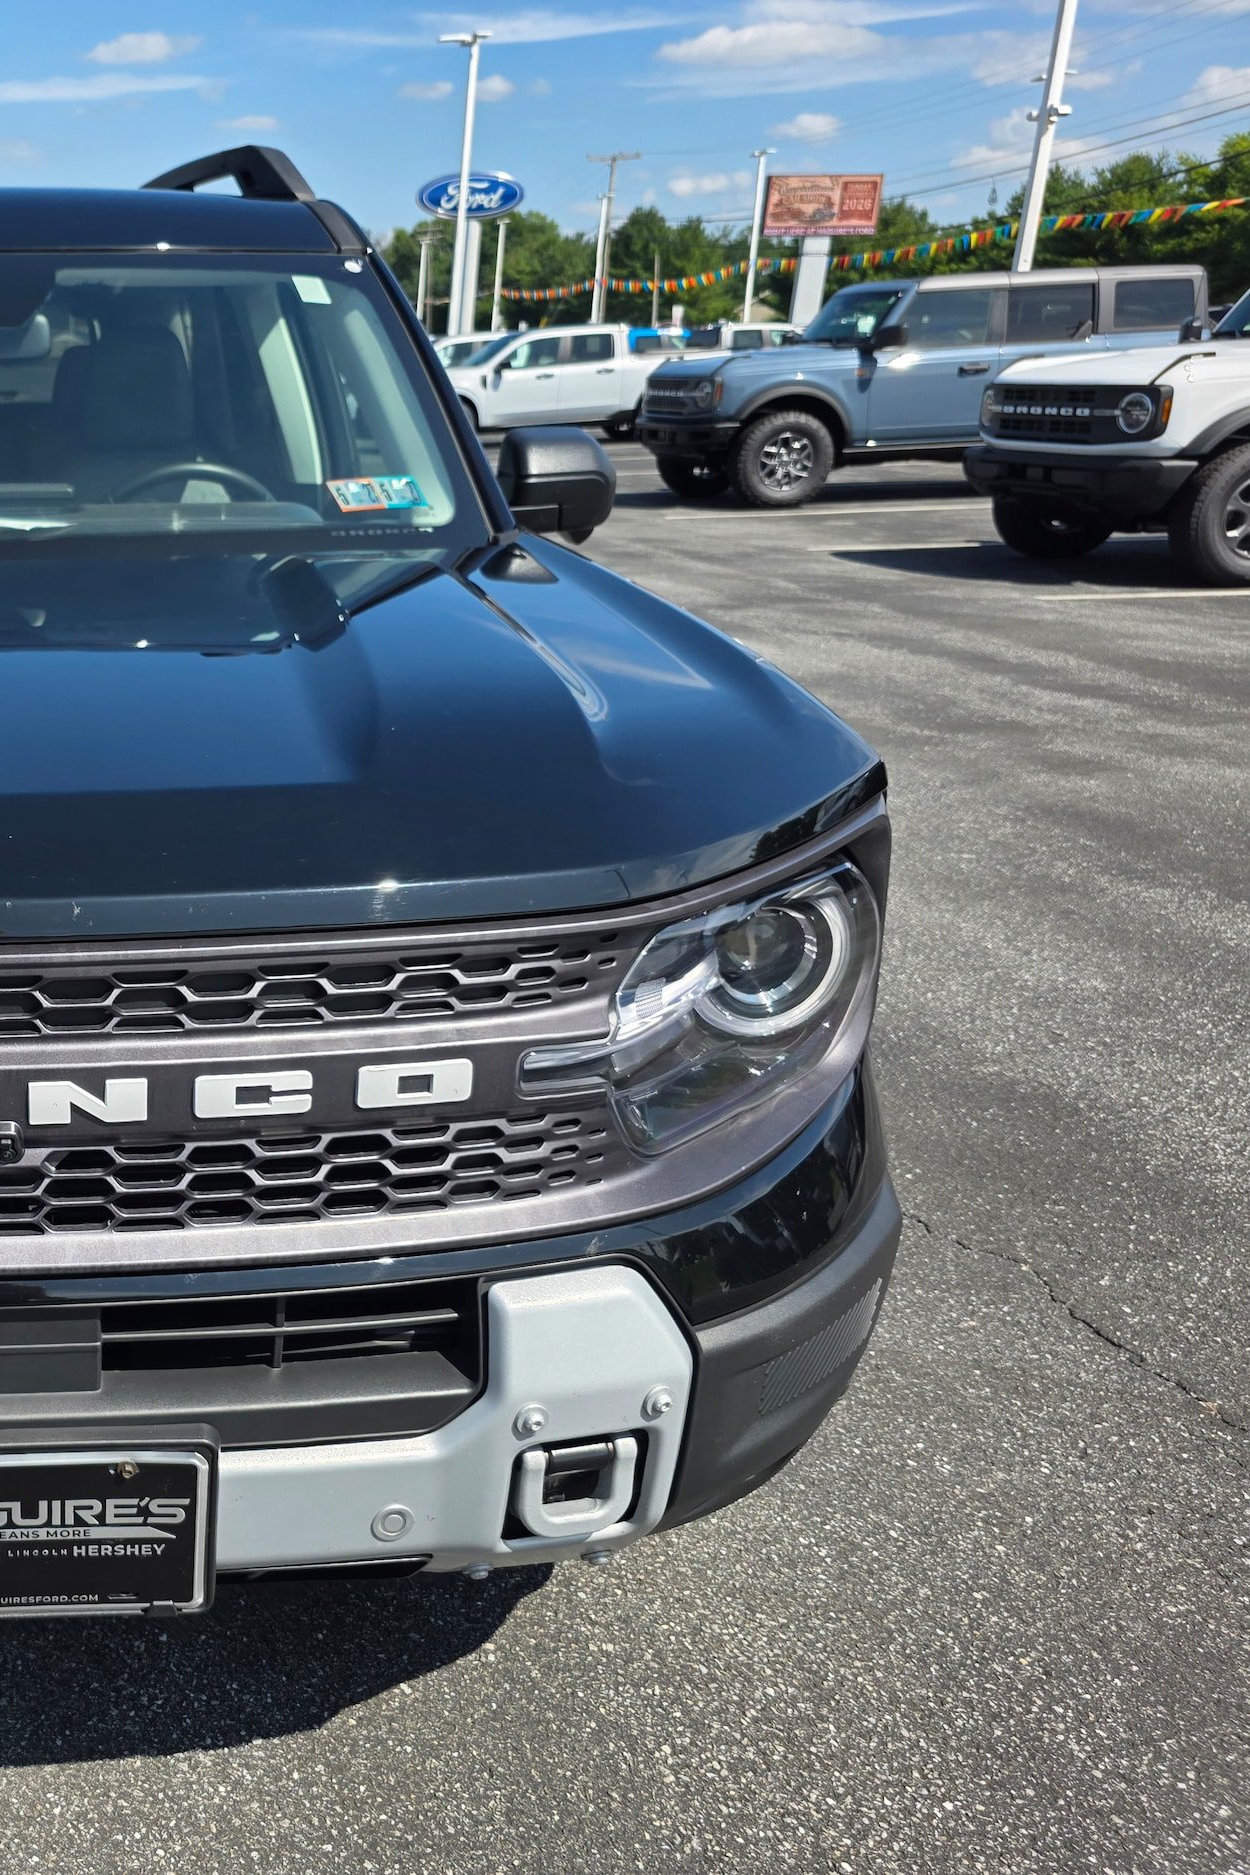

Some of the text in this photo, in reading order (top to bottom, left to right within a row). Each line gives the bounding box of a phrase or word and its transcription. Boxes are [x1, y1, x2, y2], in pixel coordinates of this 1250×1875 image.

[1003, 405, 1090, 417] BRONCO
[46, 1528, 92, 1538] MORE
[8, 1548, 68, 1558] LINCOLN
[72, 1543, 166, 1558] HERSHEY
